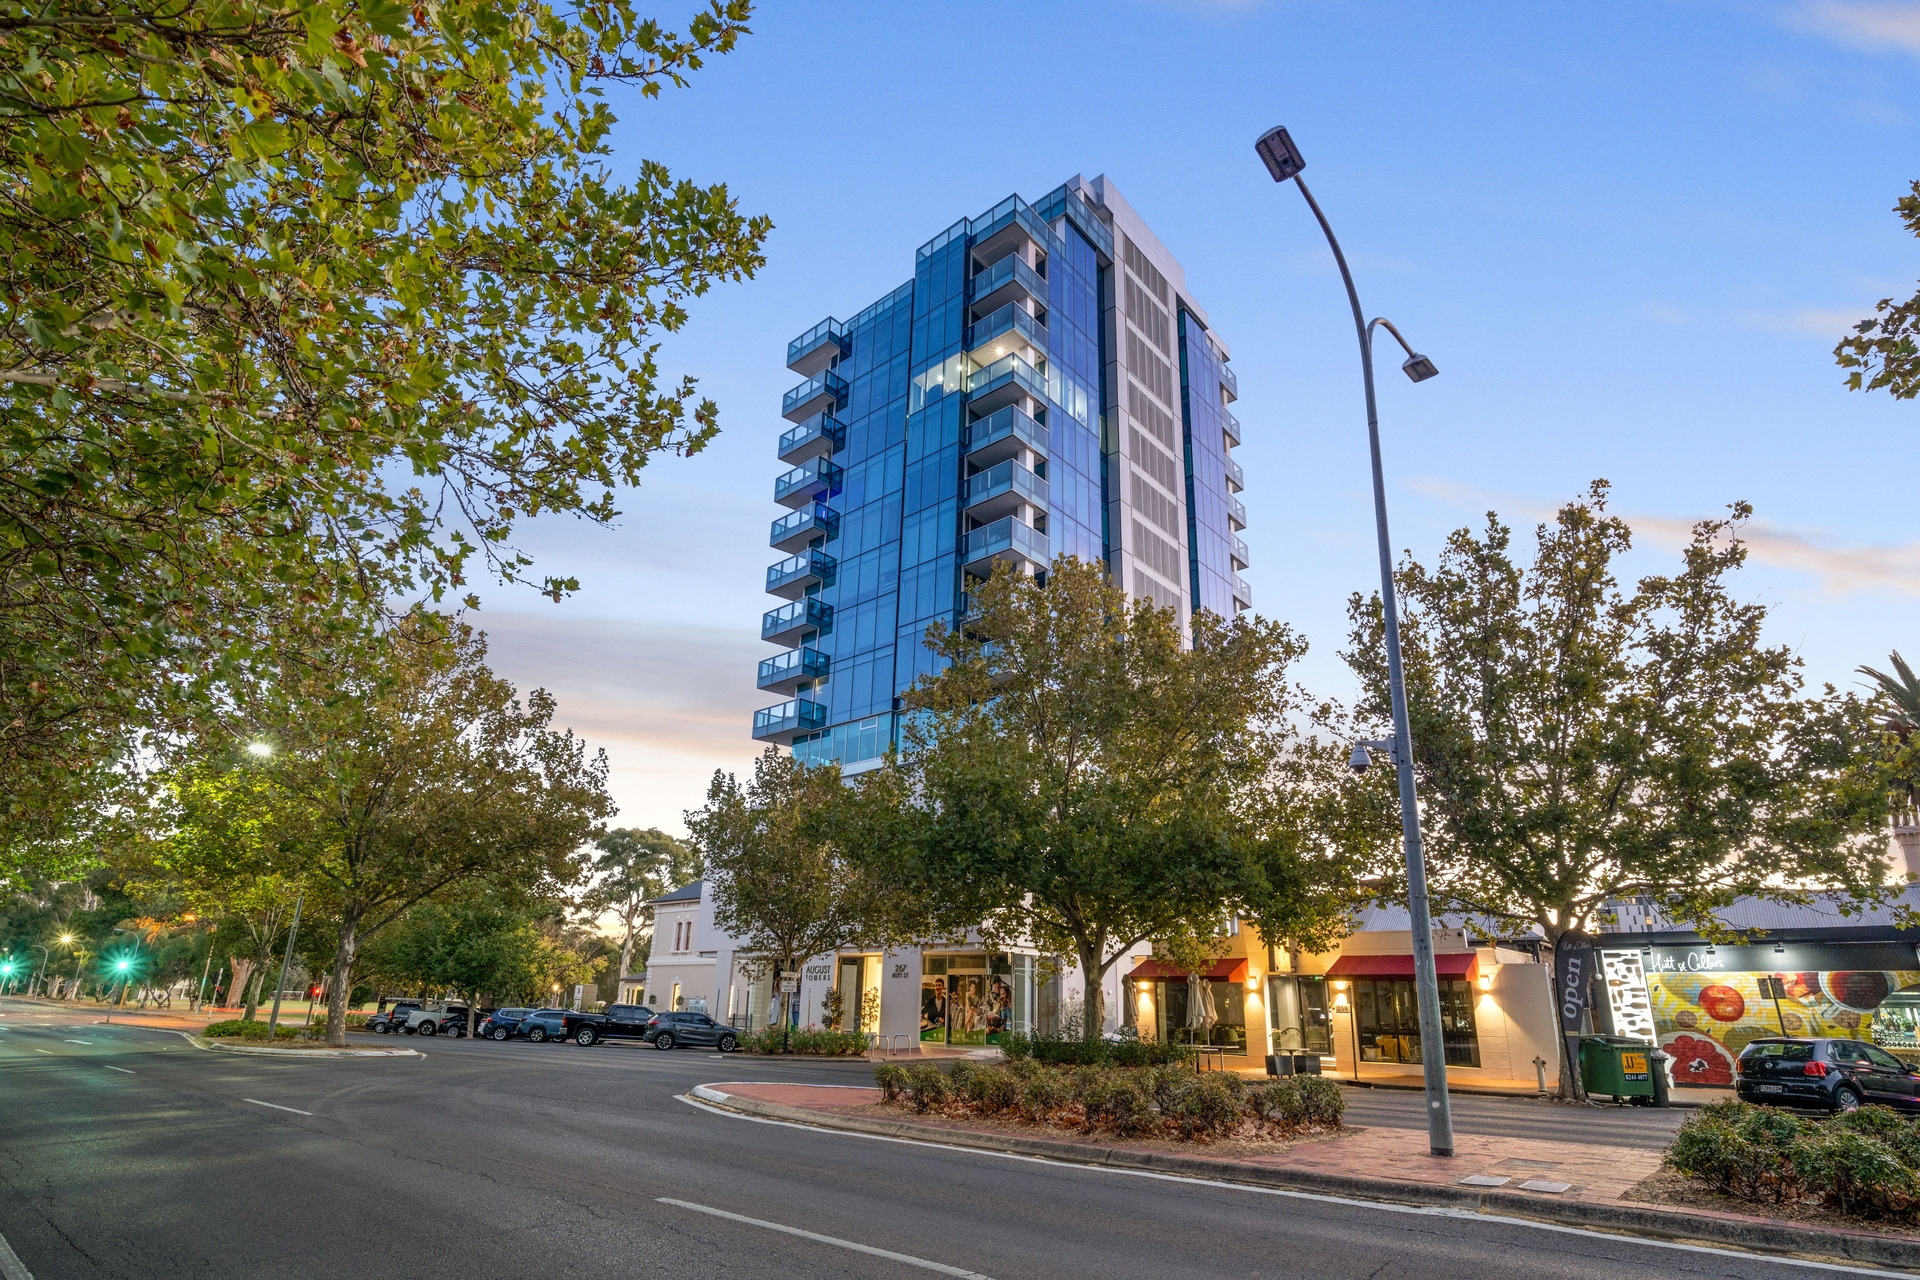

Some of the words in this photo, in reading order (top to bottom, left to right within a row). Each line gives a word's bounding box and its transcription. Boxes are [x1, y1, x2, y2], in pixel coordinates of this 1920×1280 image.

[806, 965, 831, 974] AUGUST
[894, 964, 907, 973] 267
[1648, 951, 1676, 973] Hutt
[1687, 952, 1725, 971] Cellars
[1563, 957, 1583, 1019] open
